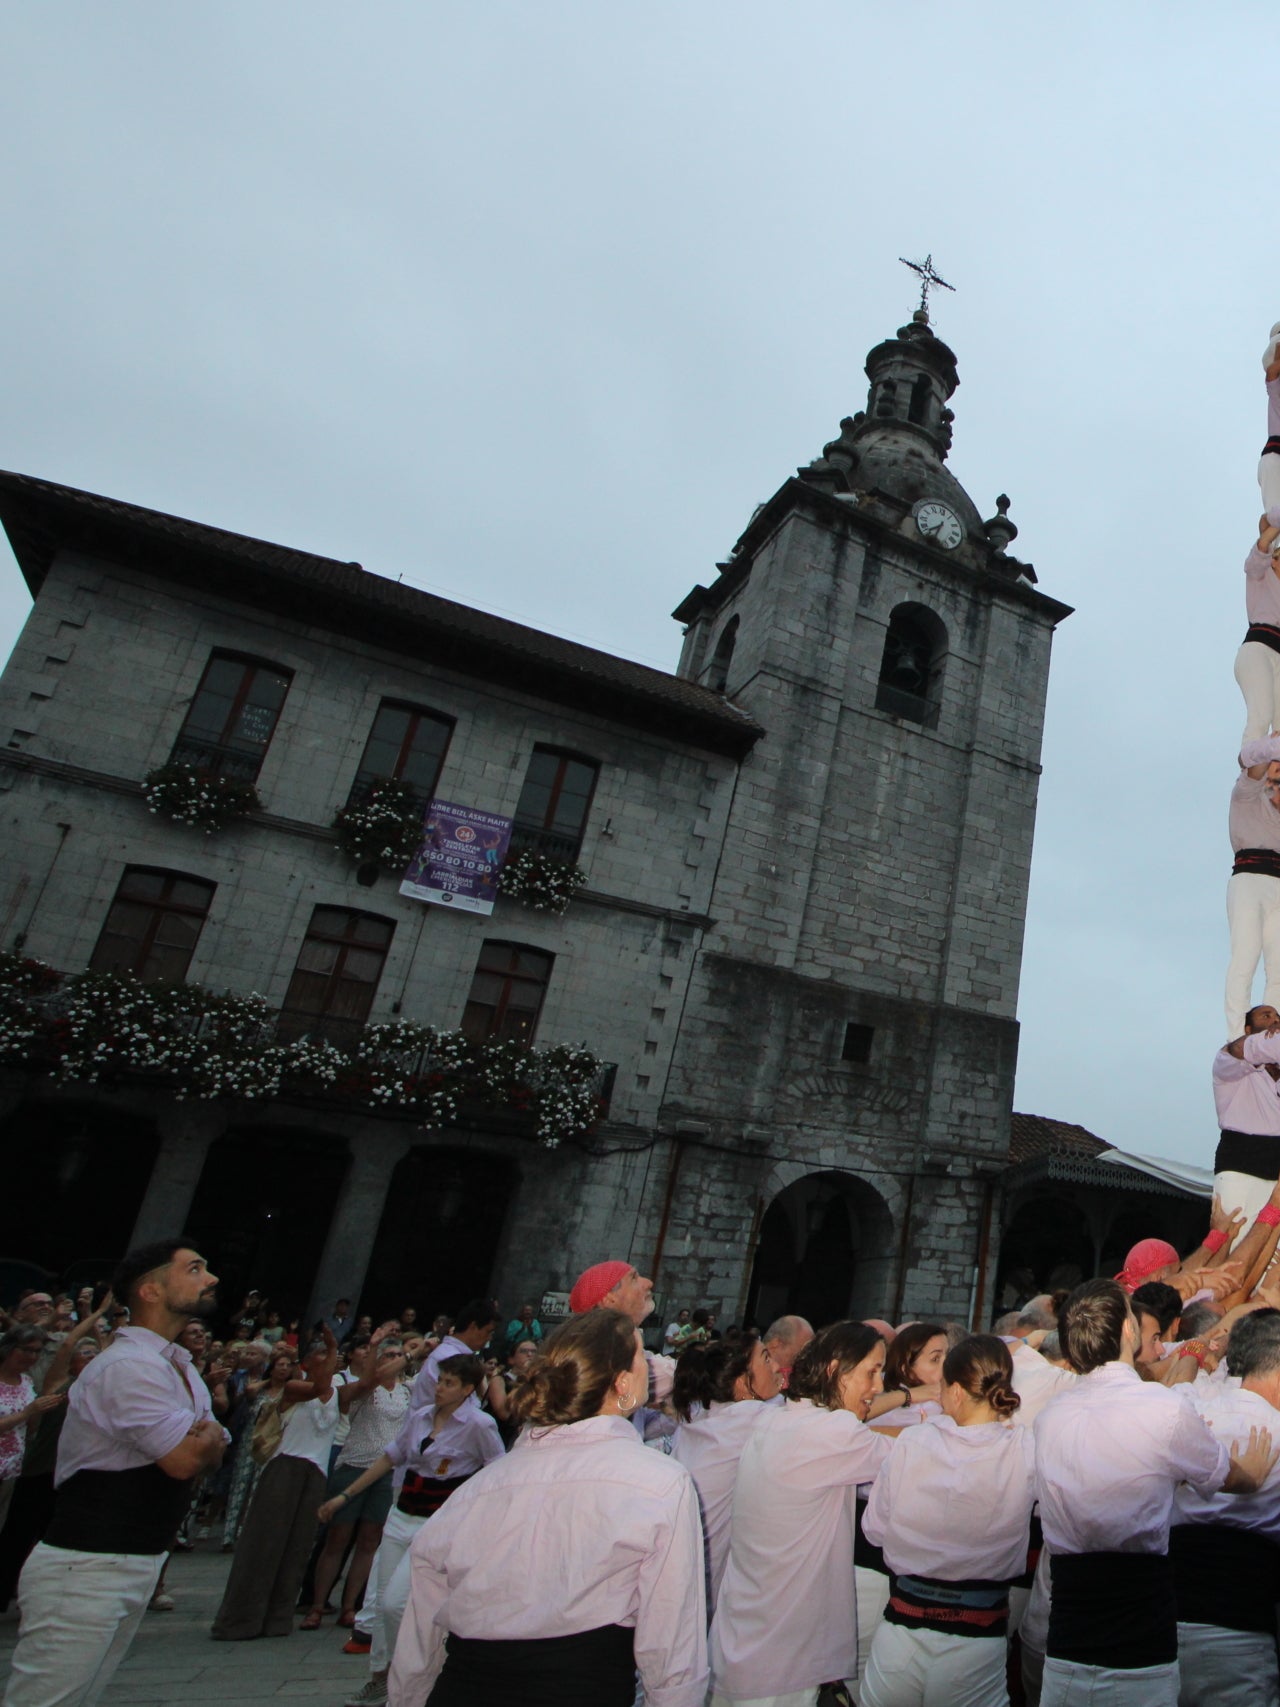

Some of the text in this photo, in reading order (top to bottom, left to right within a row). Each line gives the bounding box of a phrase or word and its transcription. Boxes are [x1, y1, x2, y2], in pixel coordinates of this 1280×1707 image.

[431, 803, 450, 812] LIBRE
[469, 811, 486, 821] ASKE
[488, 818, 509, 828] MAITE
[423, 850, 444, 860] 650
[446, 856, 461, 866] 80
[462, 860, 476, 869] 10
[476, 863, 492, 873] 80
[442, 882, 460, 892] 112
